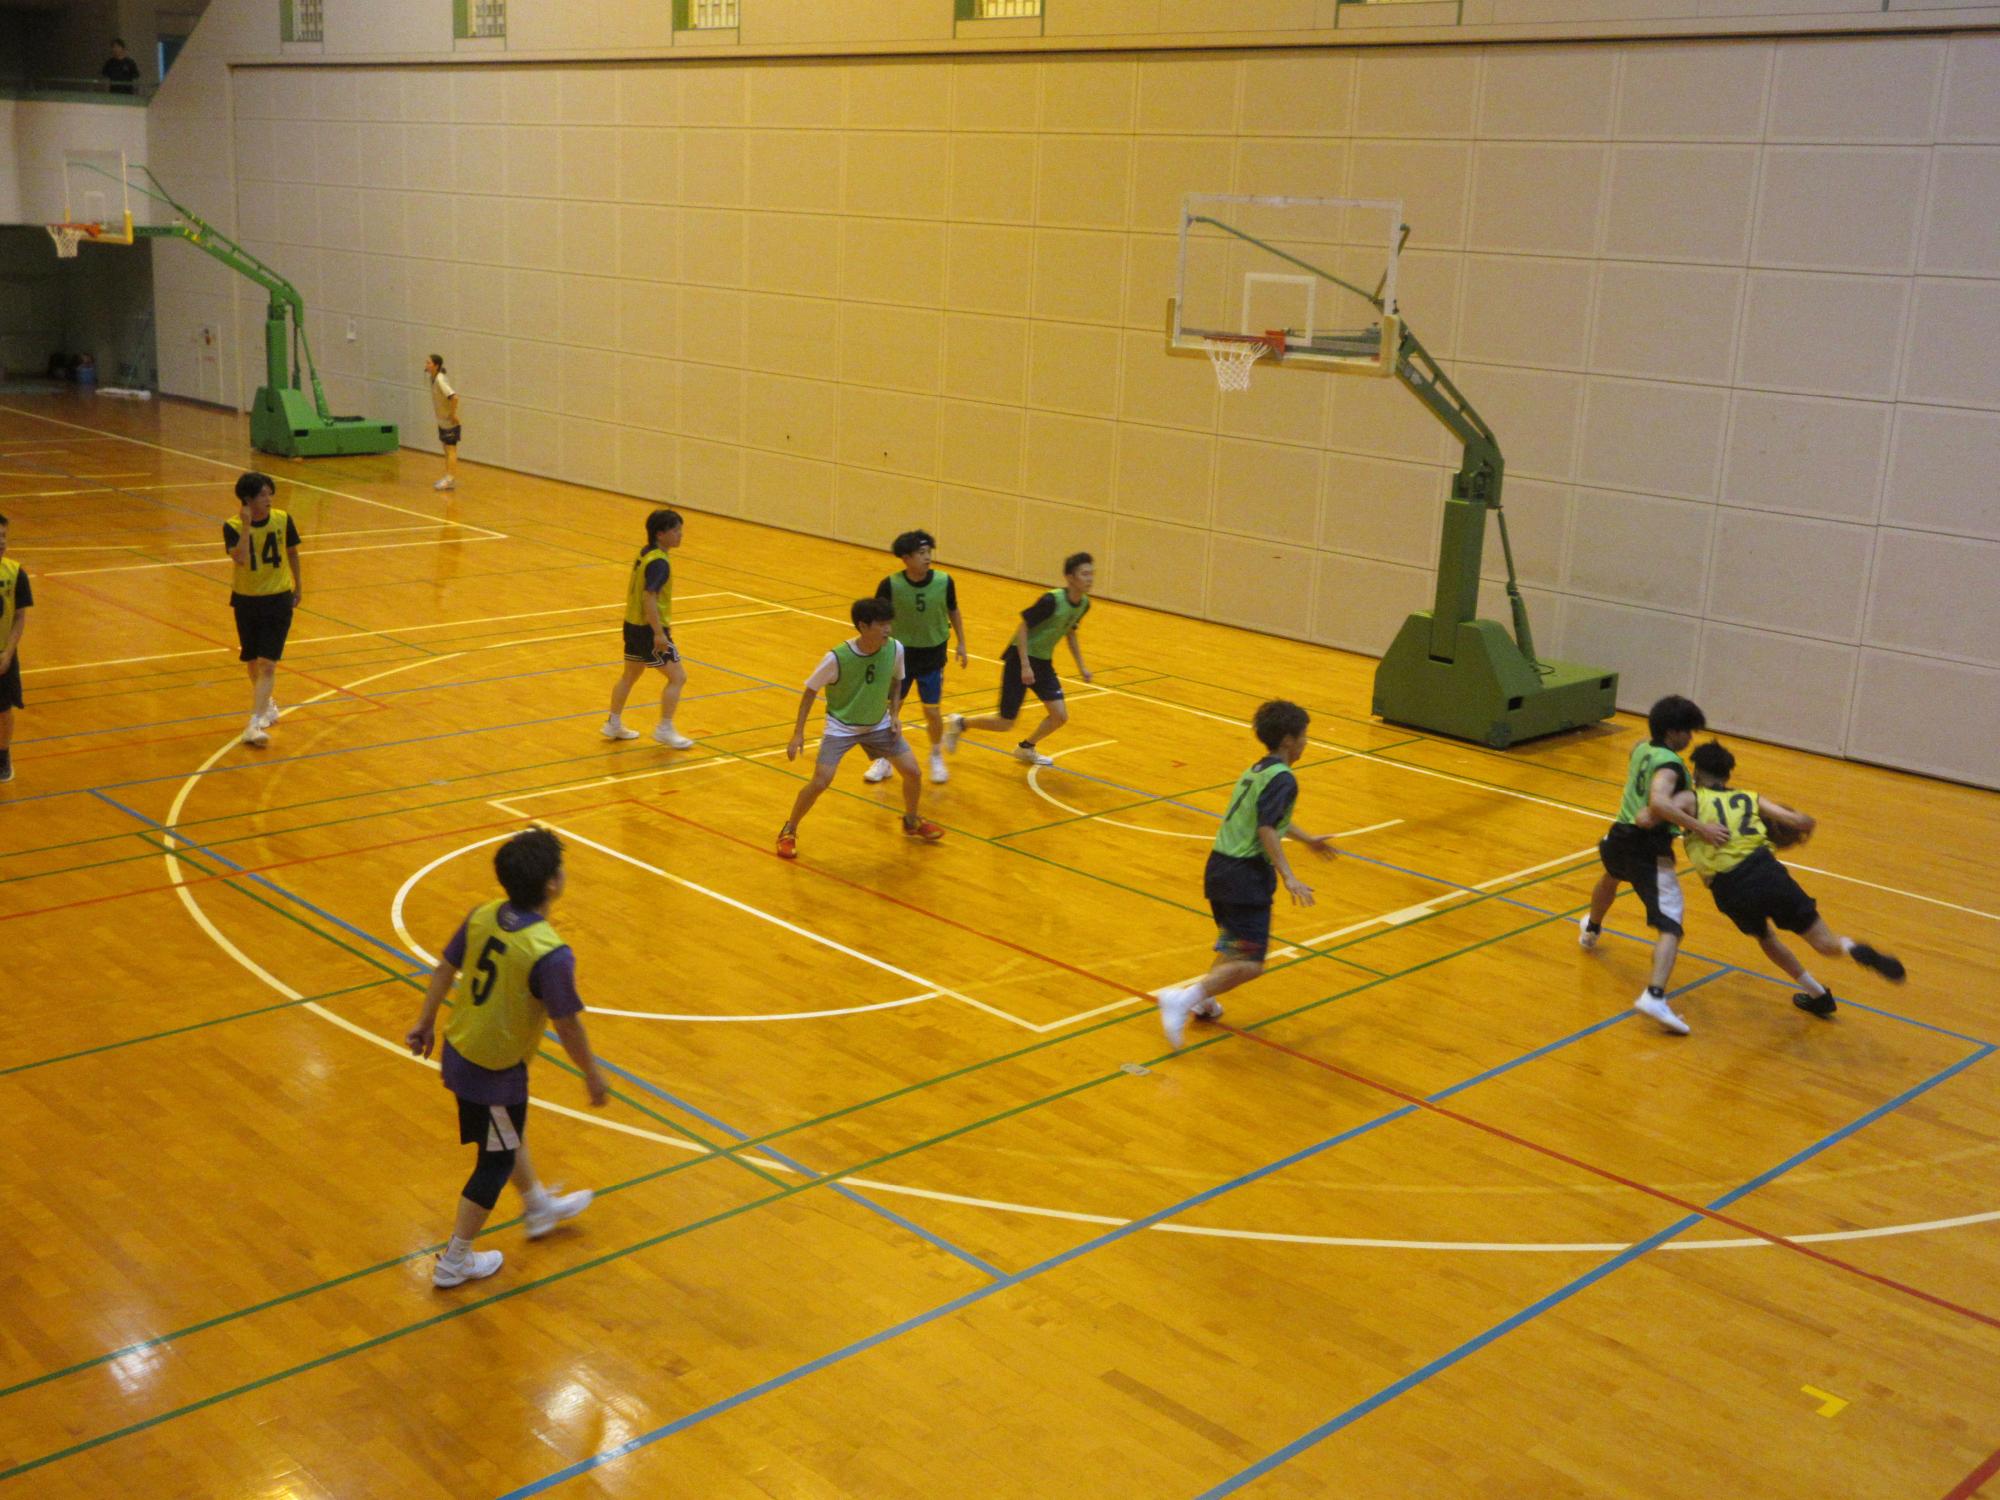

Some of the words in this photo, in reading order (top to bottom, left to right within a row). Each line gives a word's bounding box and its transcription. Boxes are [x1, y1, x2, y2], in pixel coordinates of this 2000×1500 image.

[249, 531, 281, 571] 14
[915, 593, 926, 612] 5
[865, 664, 876, 684] 6
[1225, 779, 1253, 822] 7
[1713, 793, 1760, 836] 12
[472, 936, 507, 1006] 5
